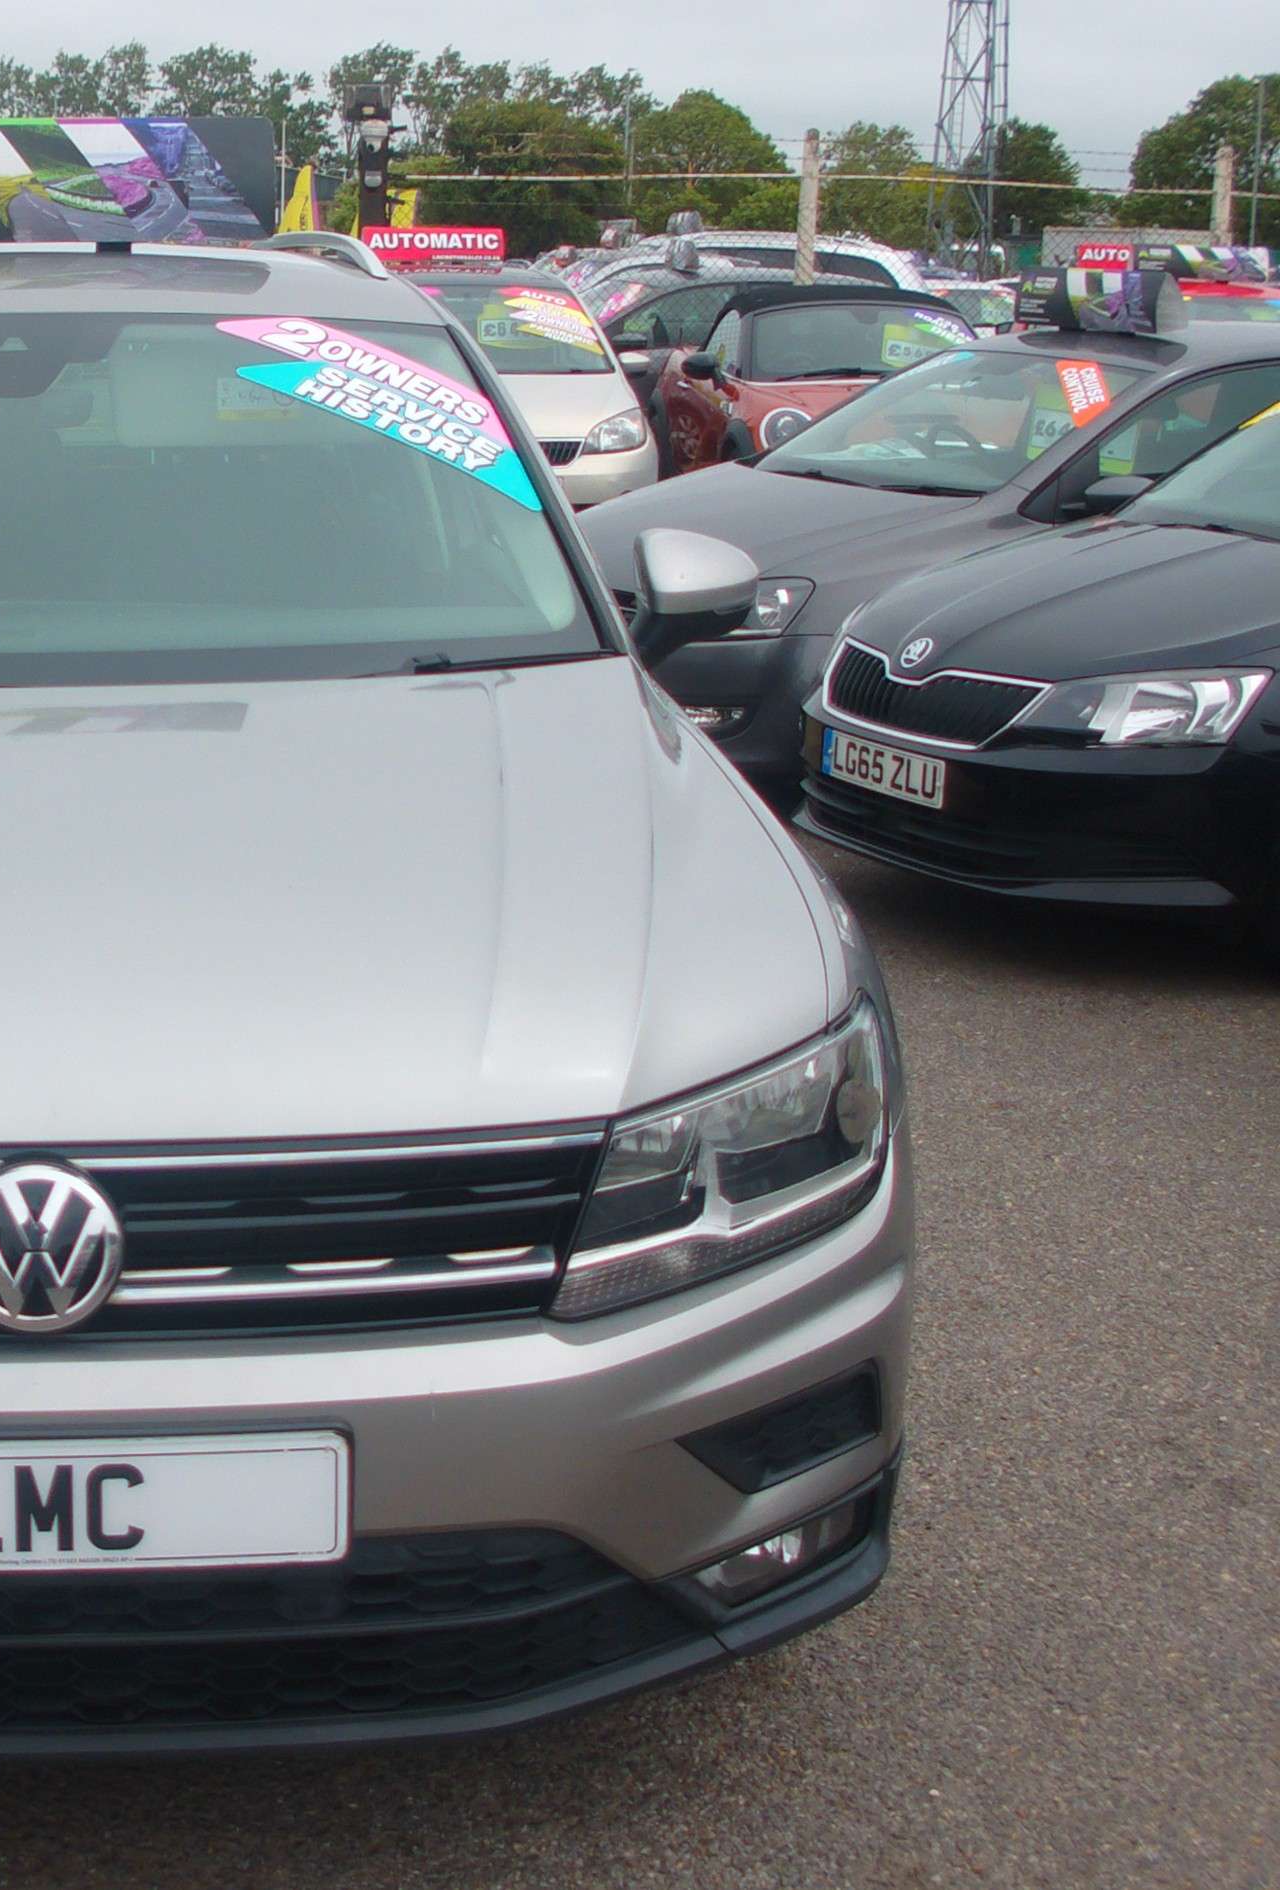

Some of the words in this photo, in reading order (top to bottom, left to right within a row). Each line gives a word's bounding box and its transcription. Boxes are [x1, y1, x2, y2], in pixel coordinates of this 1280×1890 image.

[369, 232, 499, 249] AUTOMATIC
[1081, 247, 1130, 261] AUTO
[520, 289, 567, 306] AUTO
[260, 319, 329, 357] 2
[322, 340, 489, 426] OWNERS
[1061, 367, 1089, 413] CONTROL
[1080, 367, 1105, 405] CRUISE
[293, 378, 497, 471] HISTORY
[314, 366, 505, 461] SERVICE
[833, 736, 885, 785] LG65
[889, 755, 938, 800] ZLU
